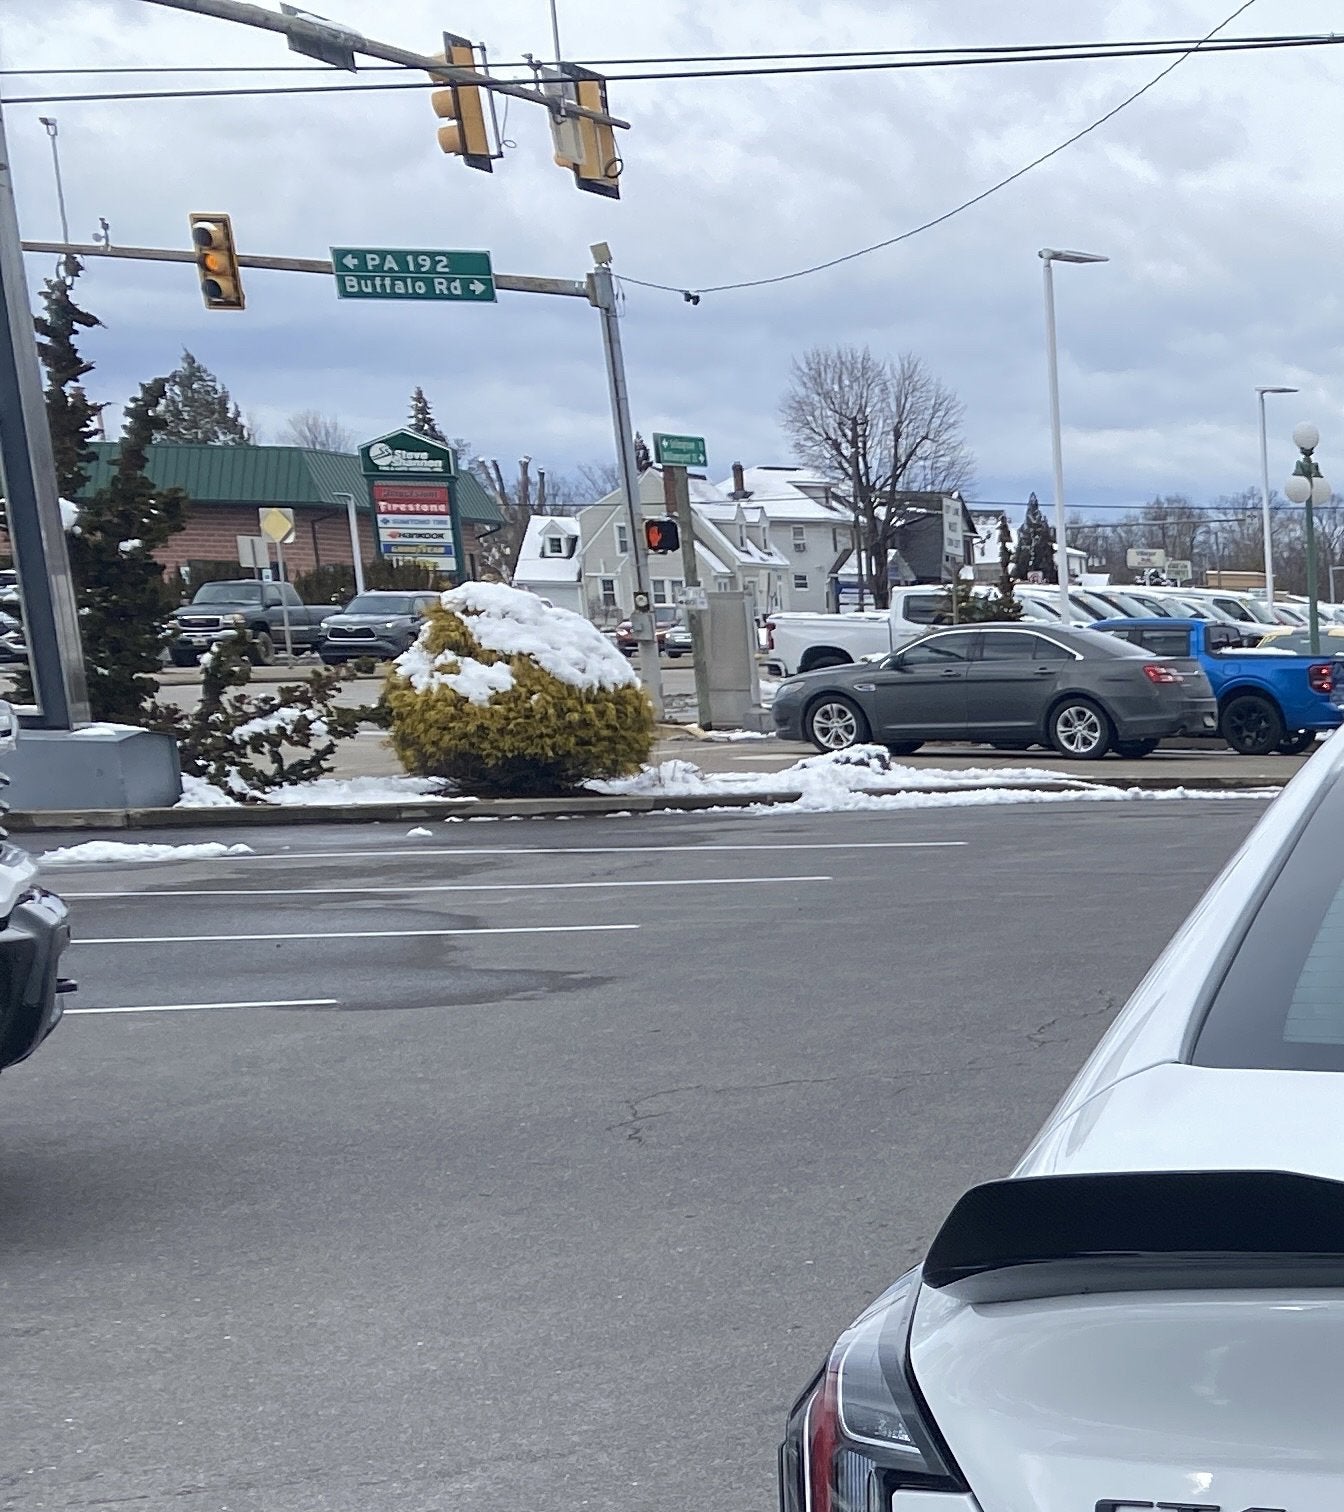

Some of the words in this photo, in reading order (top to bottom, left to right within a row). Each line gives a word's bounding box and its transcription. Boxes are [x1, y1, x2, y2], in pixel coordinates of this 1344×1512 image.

[365, 253, 399, 271] PA
[406, 255, 450, 273] 192
[344, 276, 427, 294] Buffalo
[433, 278, 463, 295] Rd
[378, 501, 447, 512] Firestone
